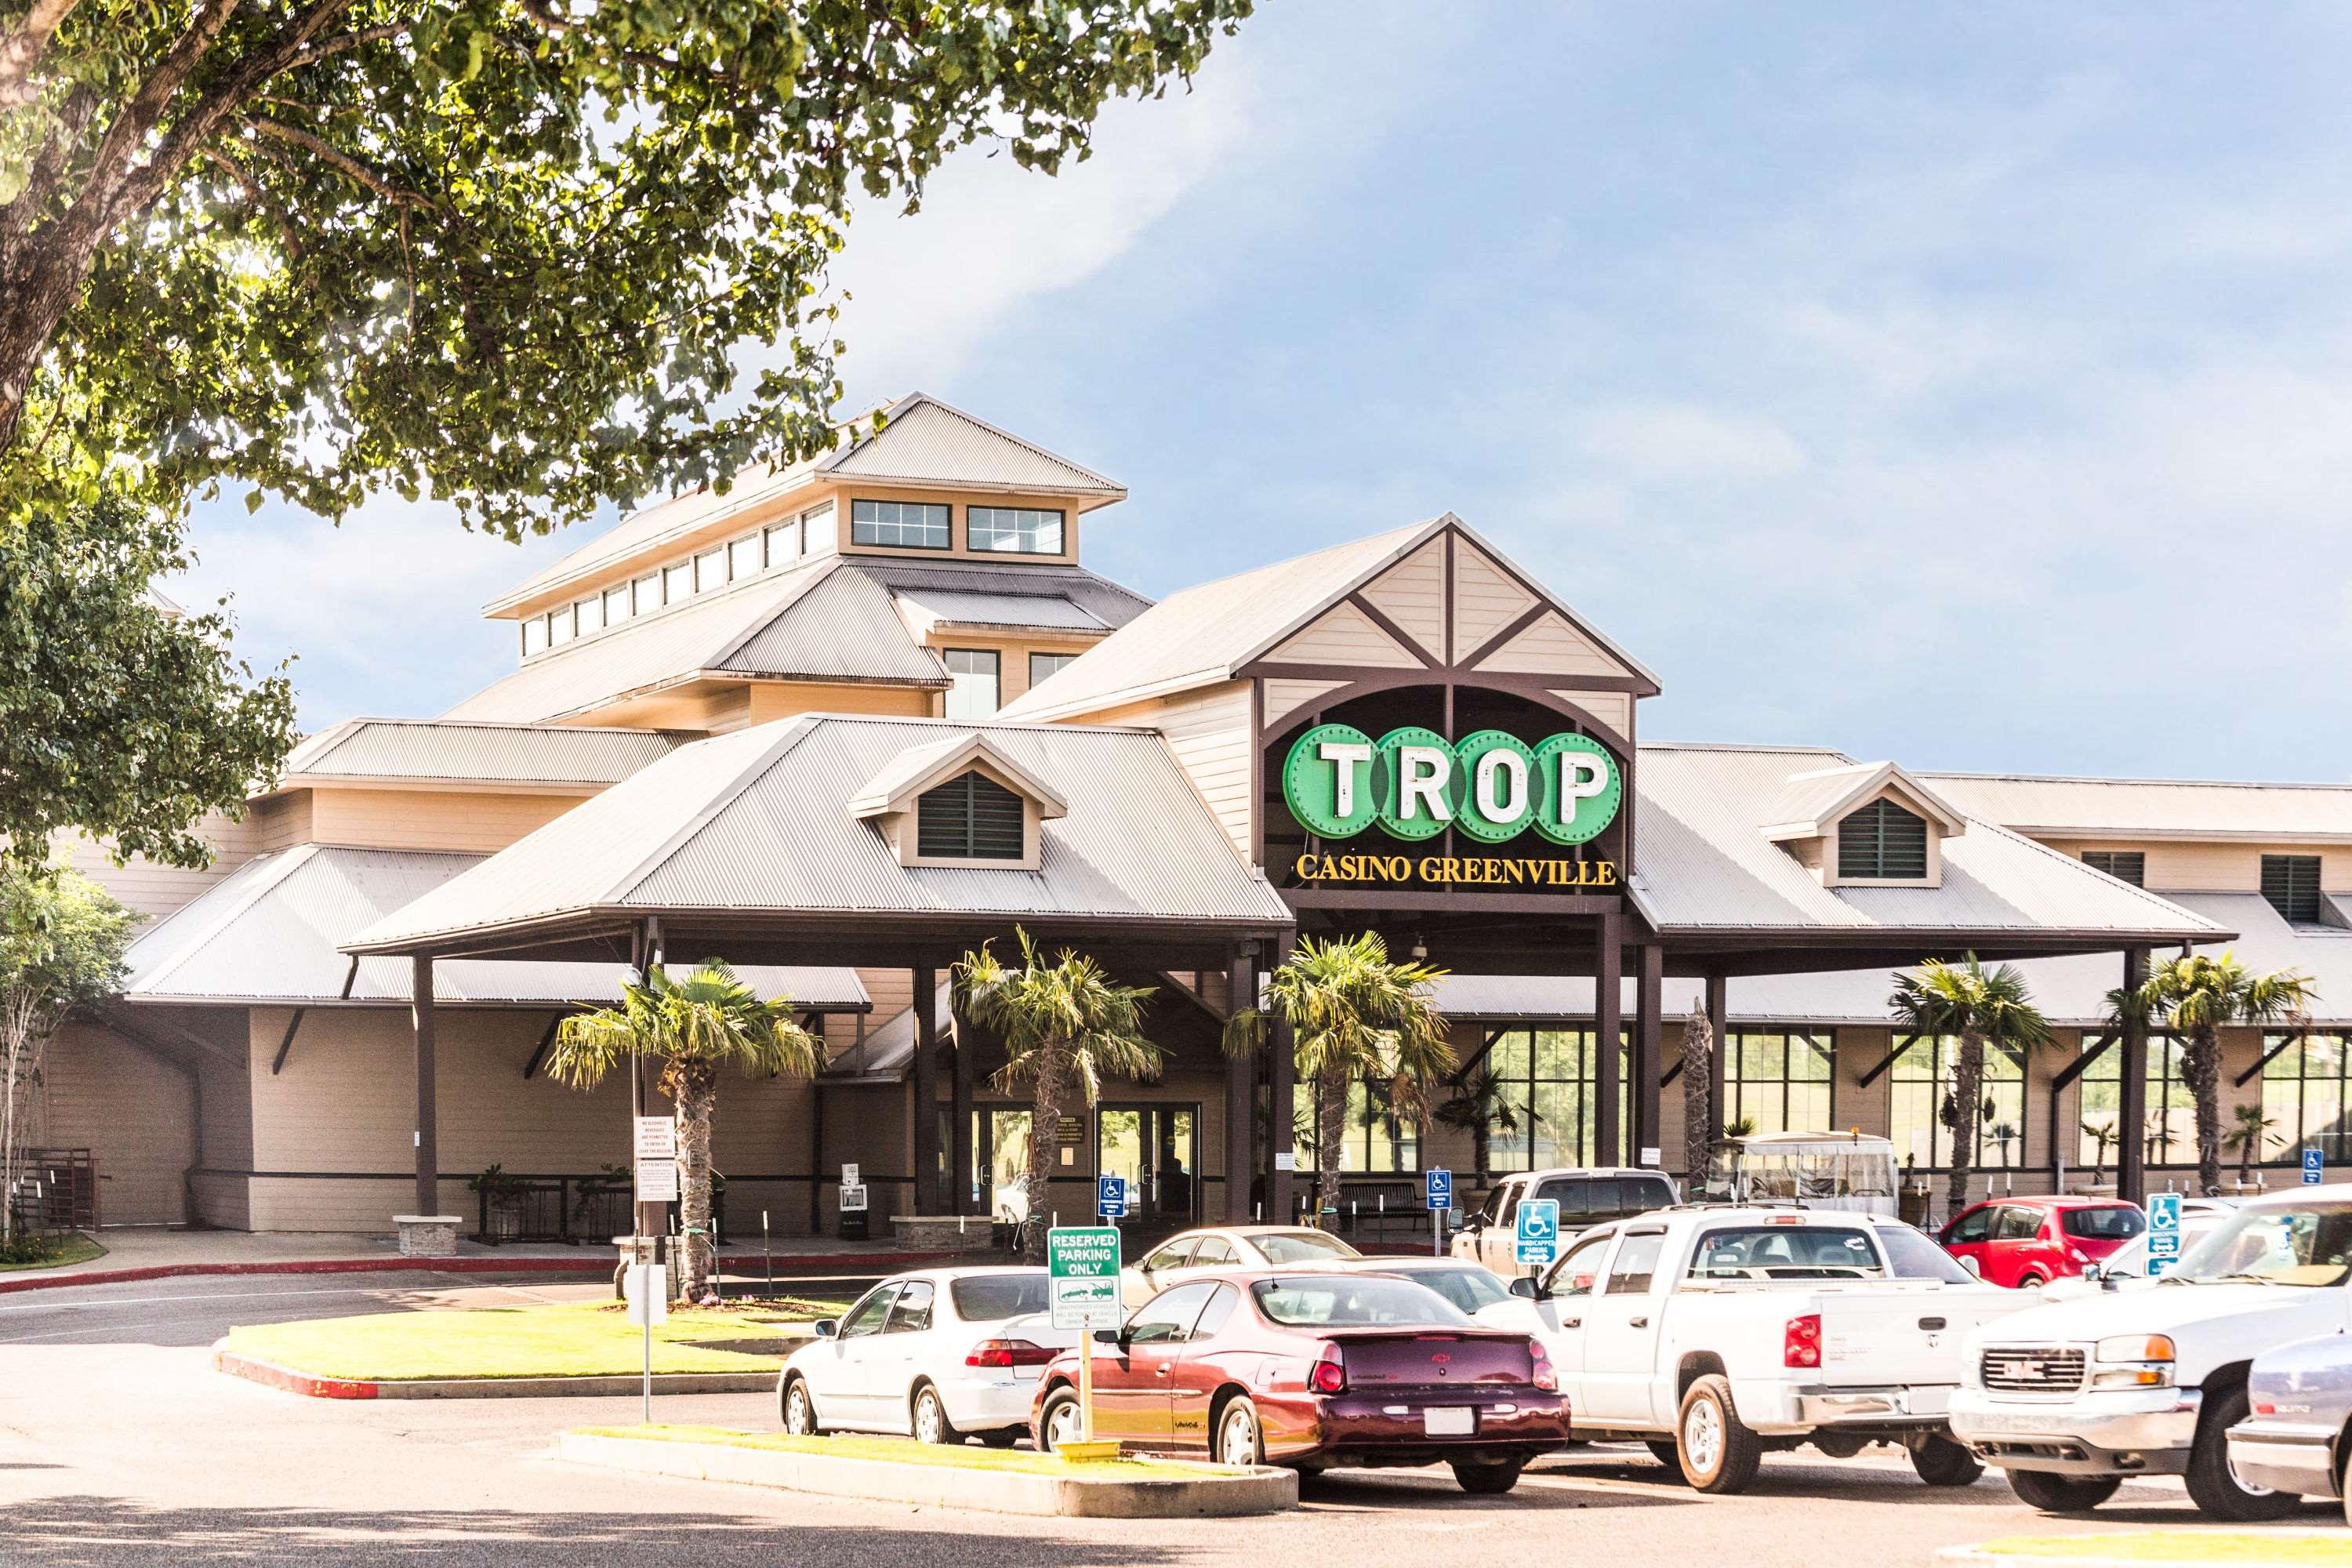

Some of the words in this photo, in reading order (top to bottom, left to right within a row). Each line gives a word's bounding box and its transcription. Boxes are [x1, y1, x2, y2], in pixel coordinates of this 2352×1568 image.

[1319, 742, 1609, 825] TROP
[1296, 854, 1412, 881] CASINO
[1419, 856, 1617, 886] GREENVILLE
[1052, 1235, 1116, 1247] RESERVED
[1058, 1250, 1111, 1261] PARKING
[1069, 1263, 1102, 1275] ONLY
